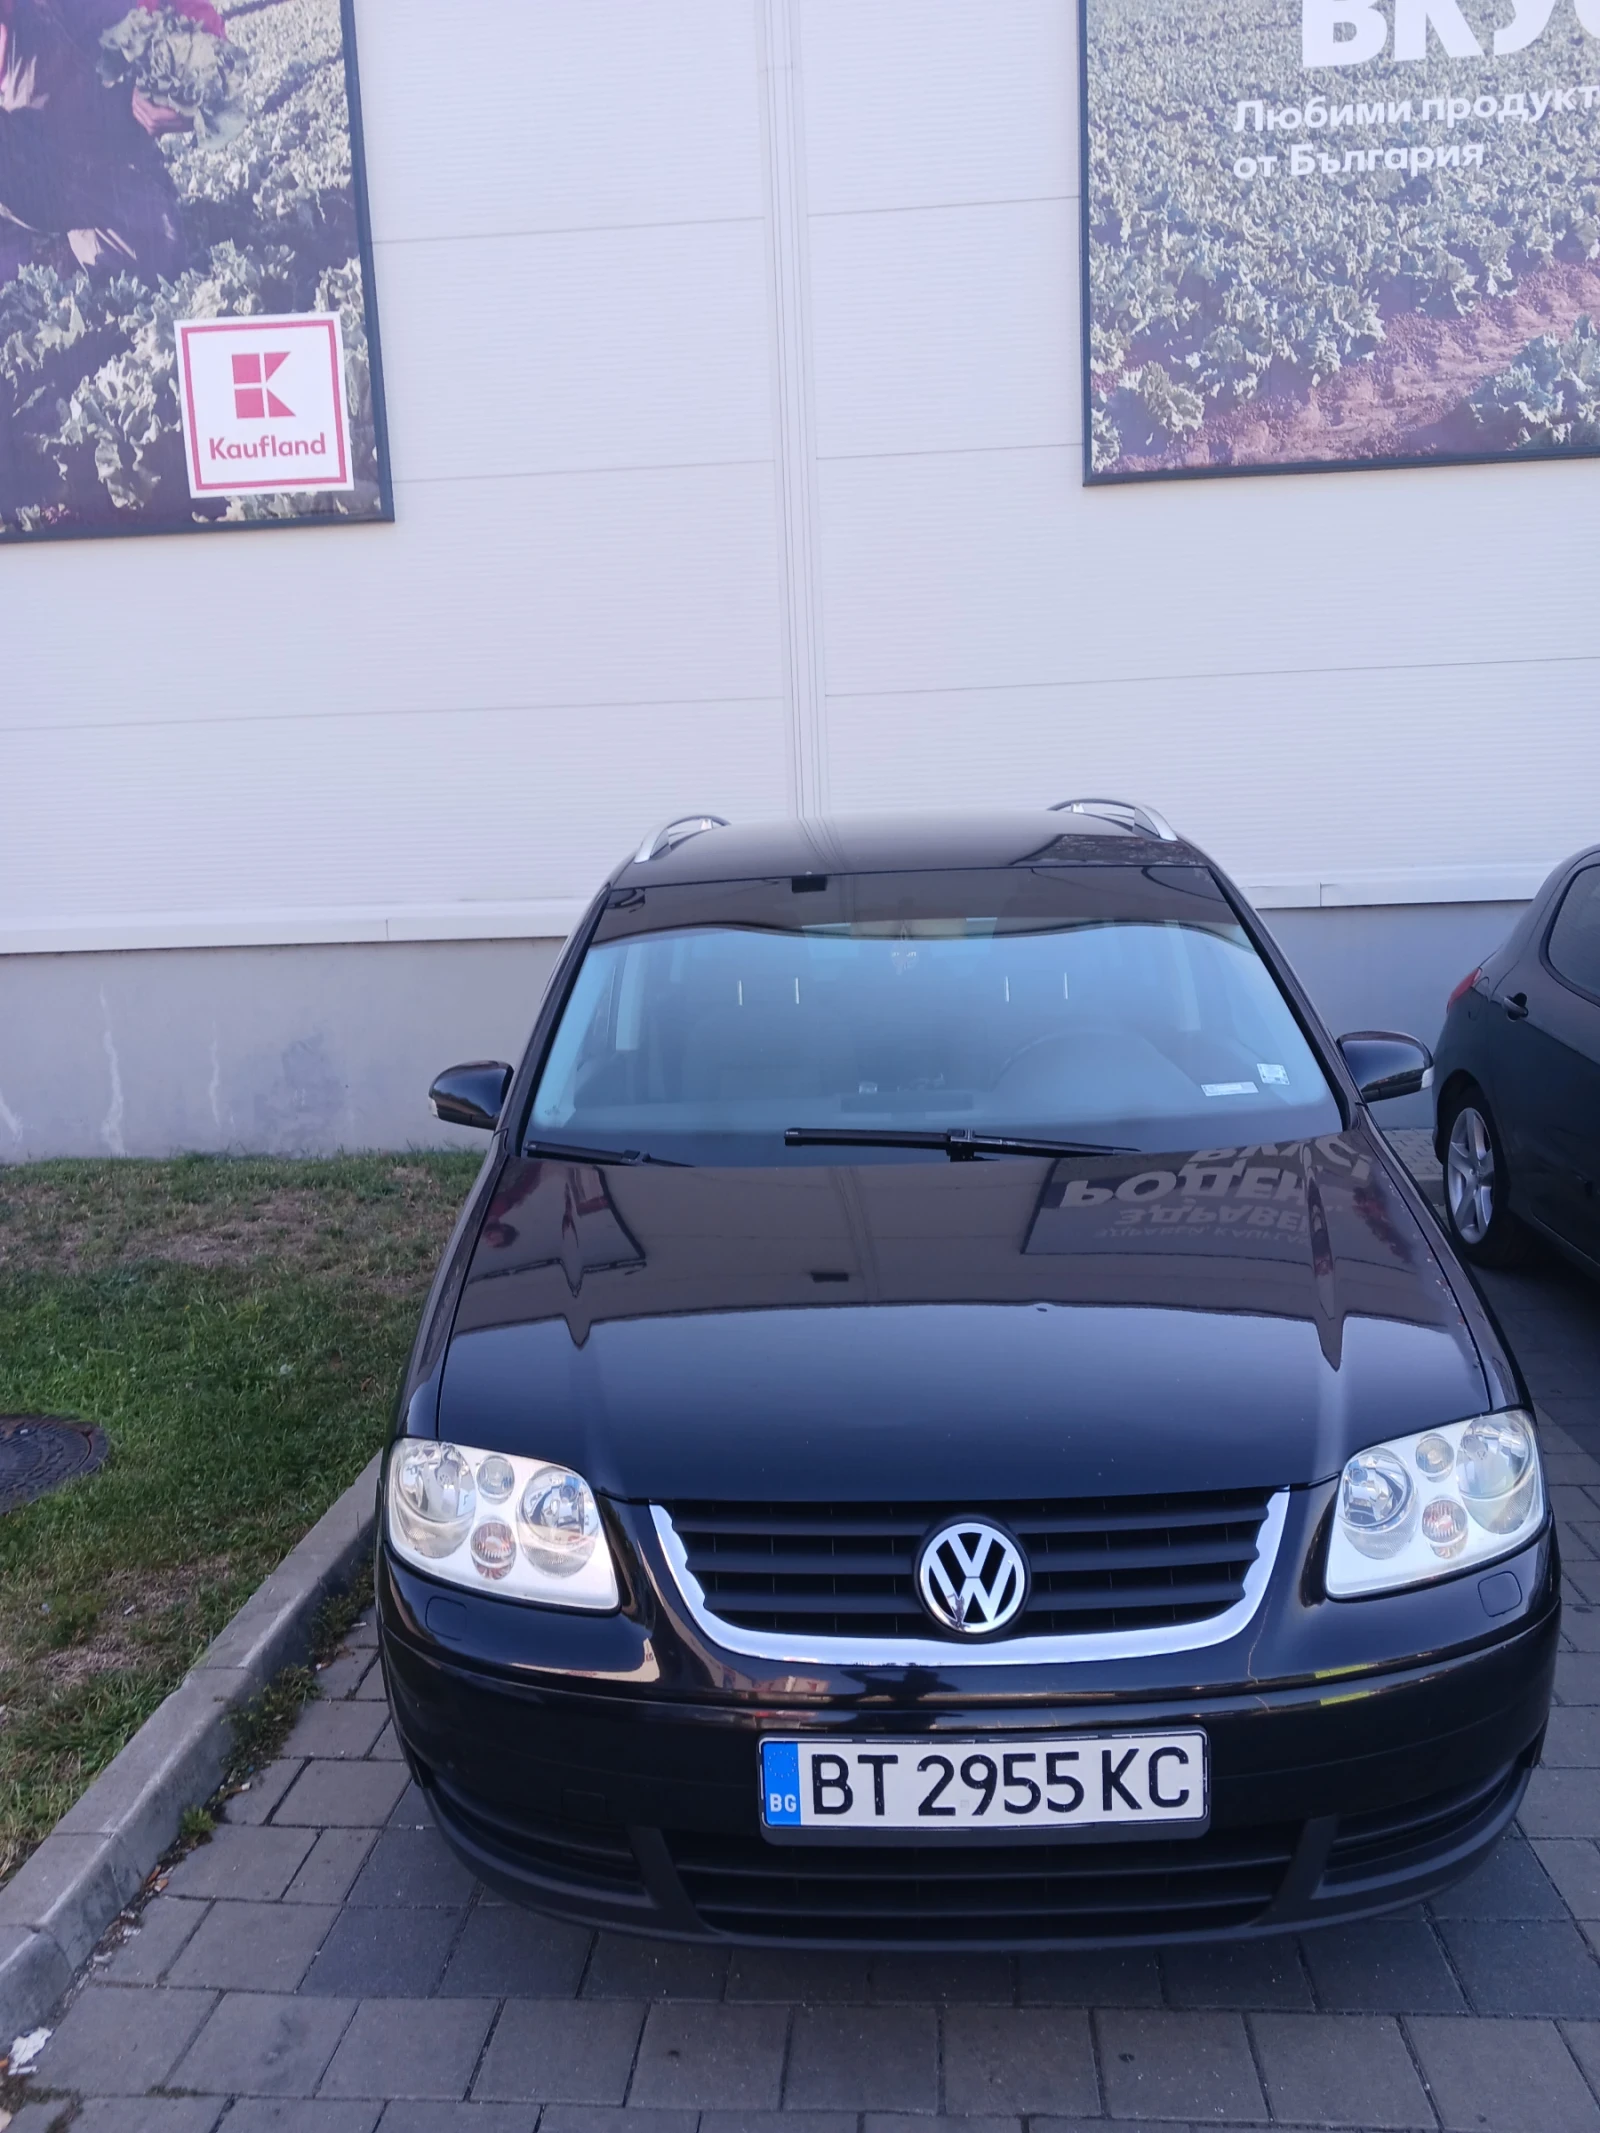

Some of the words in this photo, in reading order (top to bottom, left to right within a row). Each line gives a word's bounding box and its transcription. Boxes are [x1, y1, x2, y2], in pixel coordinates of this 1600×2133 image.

[1302, 0, 1600, 68] ВКУ
[1234, 95, 1411, 133] Любими
[1422, 85, 1600, 128] продукт
[1233, 151, 1279, 180] от
[1290, 142, 1485, 178] България
[208, 432, 327, 461] Kaufland
[769, 1793, 797, 1812] BG
[811, 1753, 899, 1816] BT
[916, 1751, 1085, 1817] 2955
[1101, 1746, 1190, 1811] KC
